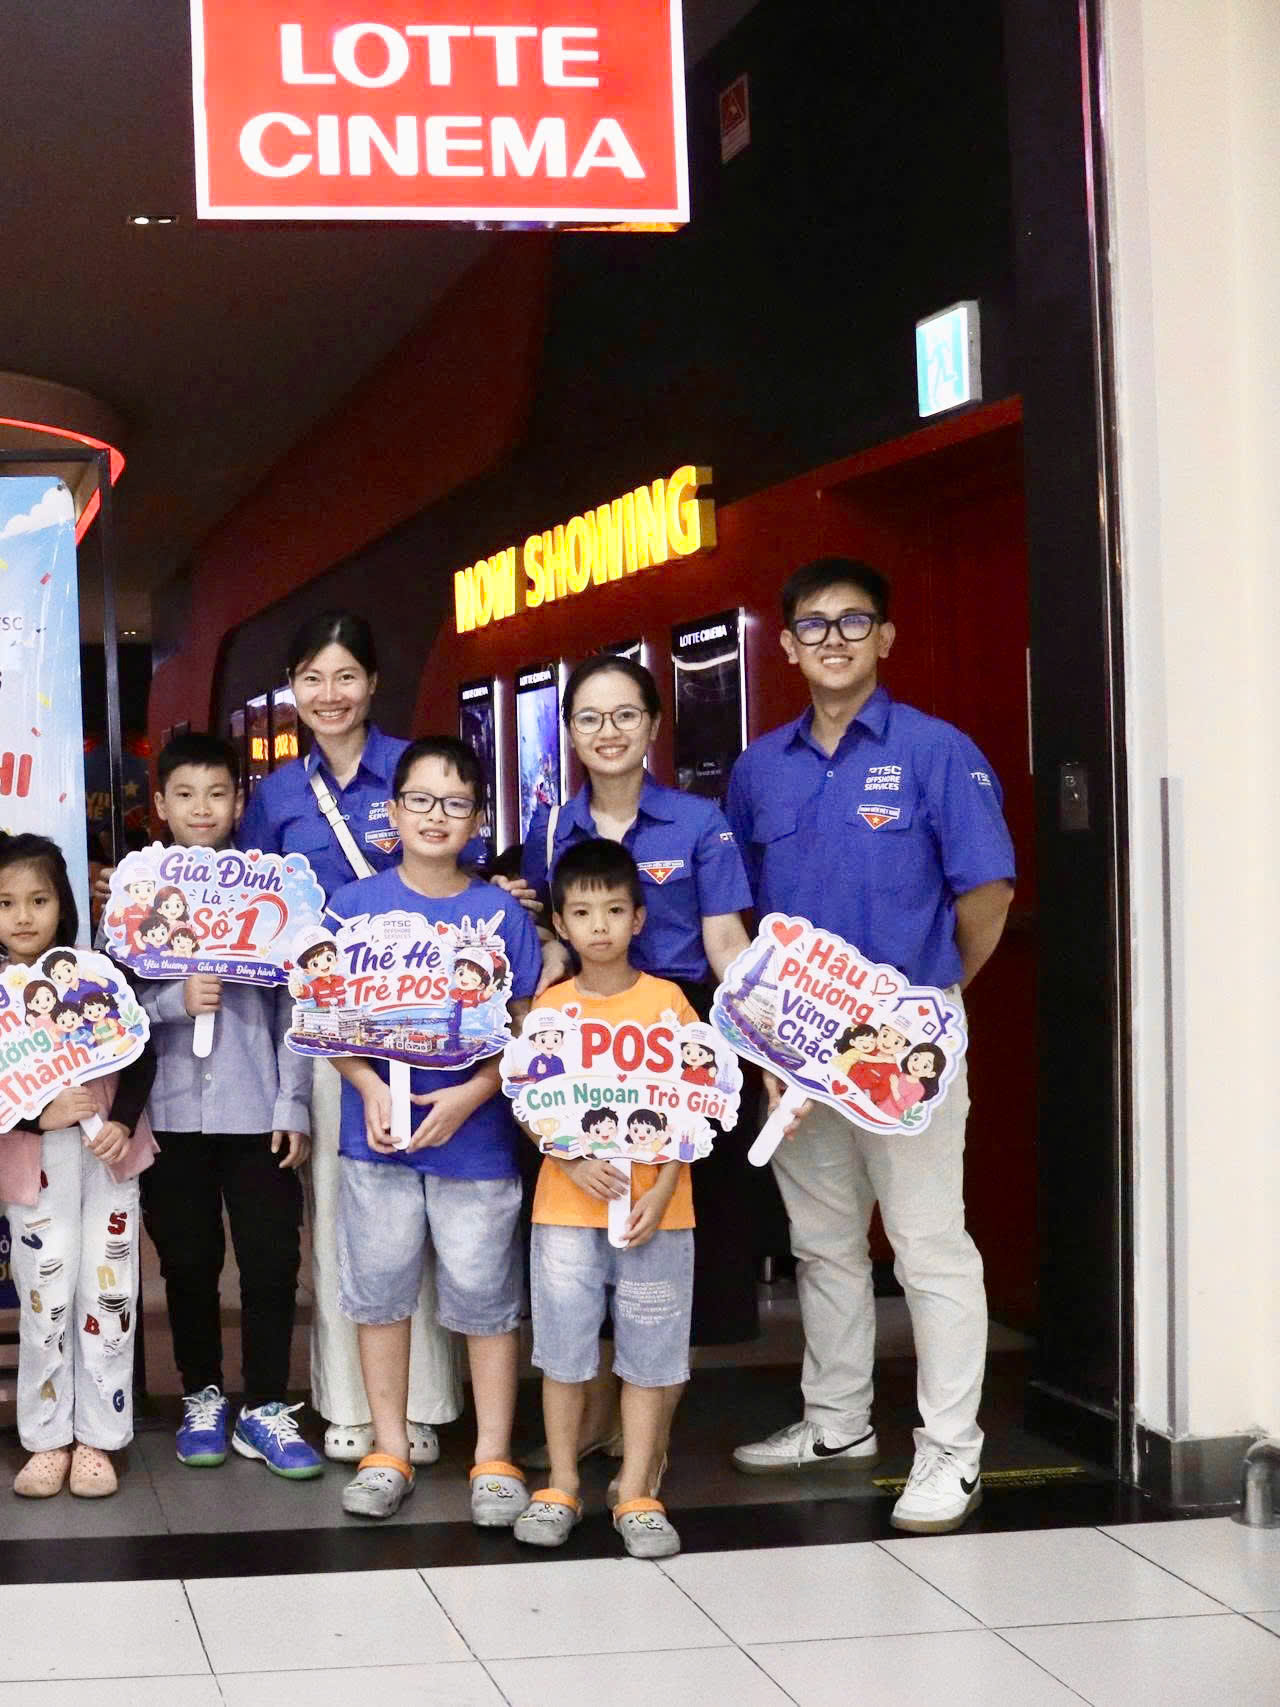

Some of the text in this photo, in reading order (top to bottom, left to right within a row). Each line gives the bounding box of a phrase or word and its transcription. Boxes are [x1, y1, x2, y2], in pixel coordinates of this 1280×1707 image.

[280, 22, 600, 88] LOTTE
[239, 112, 646, 178] CINEMA
[454, 465, 702, 633] NOW SHOWING
[160, 852, 284, 893] Gia Đình
[201, 887, 222, 904] Là
[192, 907, 260, 951] Số 1
[344, 941, 442, 974] Thế Hệ
[806, 938, 868, 990] Hậu
[347, 975, 449, 1006] Trẻ POS
[778, 957, 875, 1026] Phương
[780, 990, 840, 1040] Vững
[580, 1023, 674, 1073] POS
[776, 1019, 833, 1065] Chắc
[526, 1083, 728, 1119] Con Ngoan Trò Giỏi
